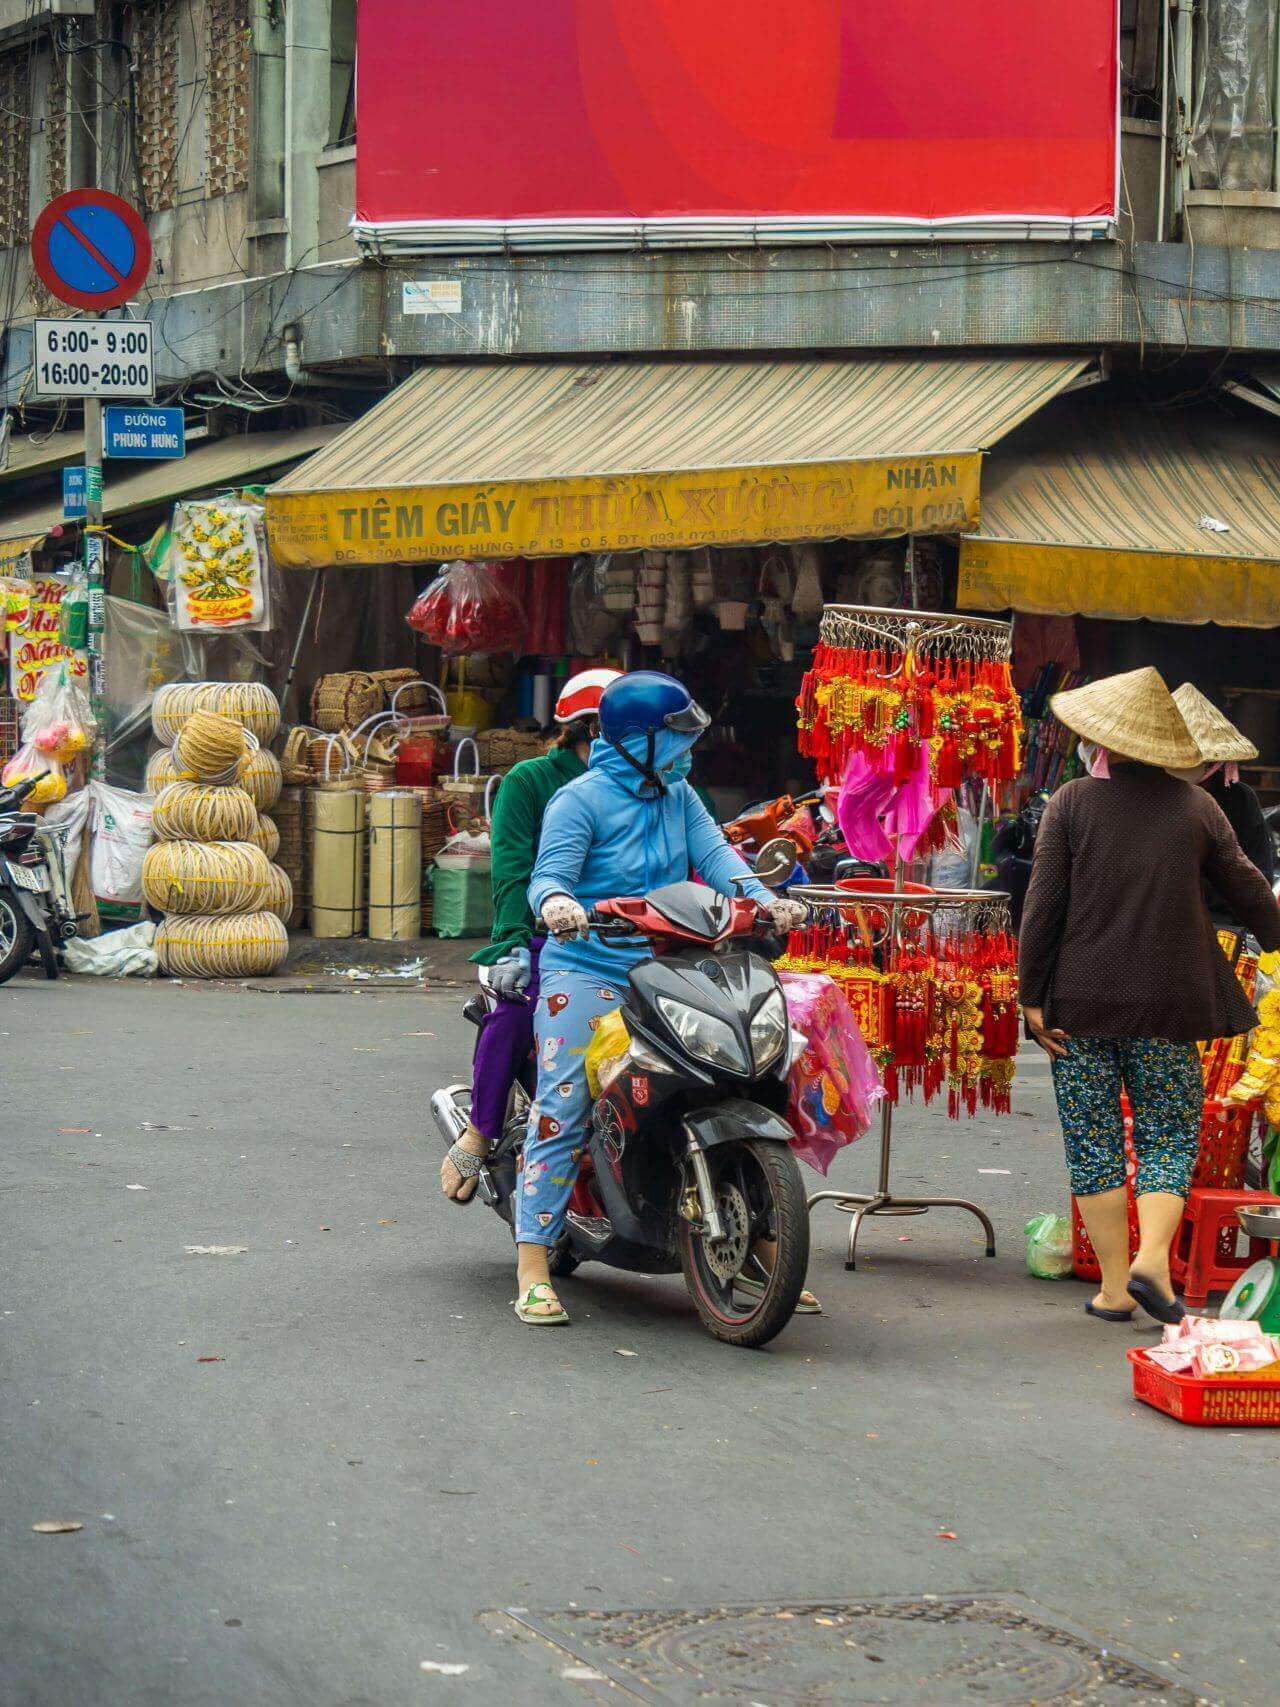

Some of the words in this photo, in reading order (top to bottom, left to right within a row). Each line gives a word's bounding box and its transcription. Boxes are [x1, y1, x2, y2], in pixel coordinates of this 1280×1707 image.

[886, 461, 957, 492] NHẬN
[337, 498, 424, 546] TIỆM
[436, 487, 517, 537] GIẤY
[872, 501, 913, 528] GÓI
[921, 497, 968, 527] QUÀ
